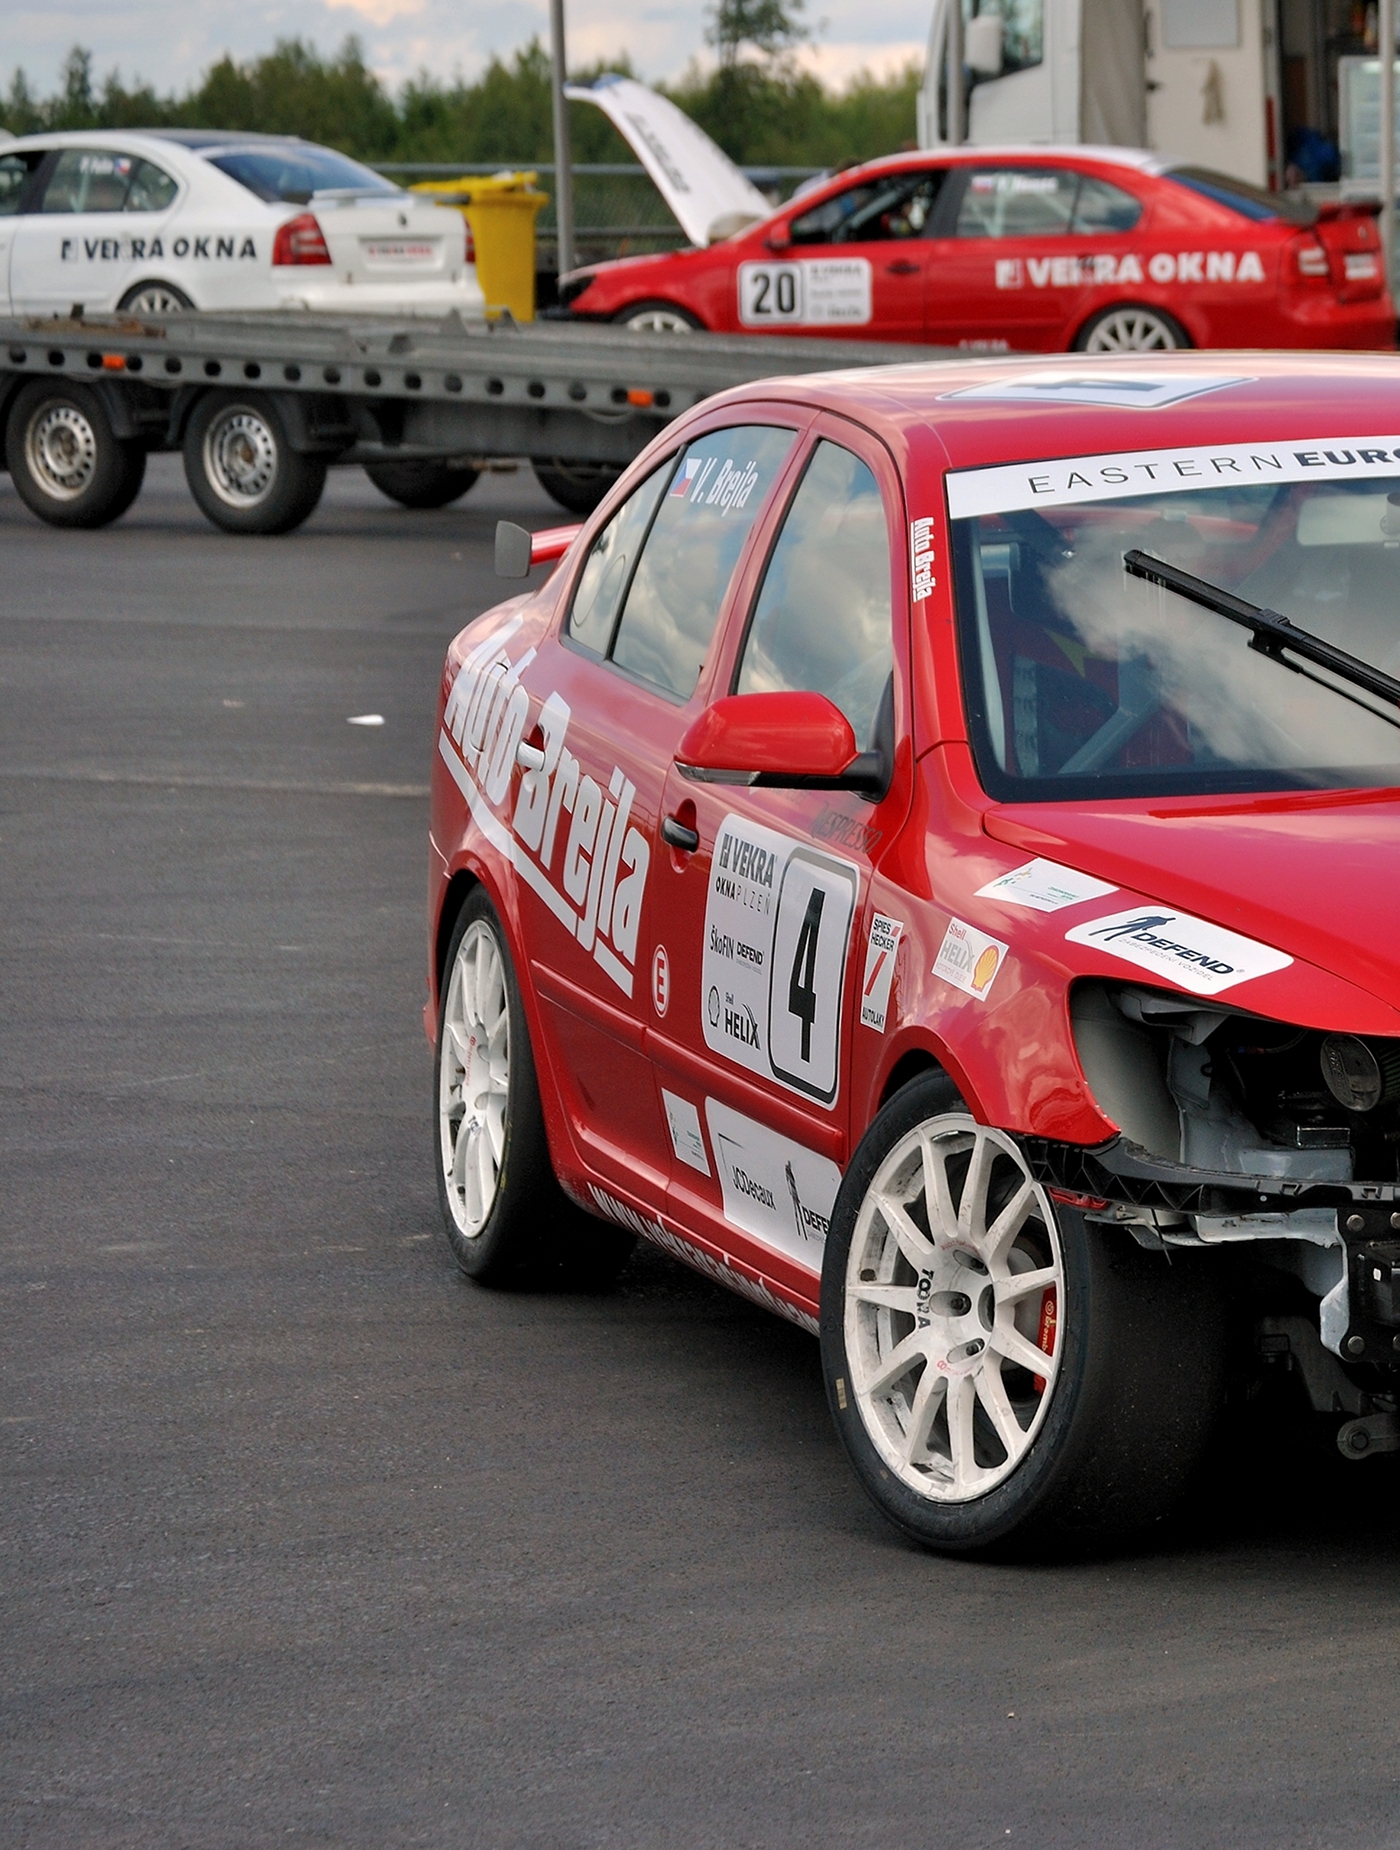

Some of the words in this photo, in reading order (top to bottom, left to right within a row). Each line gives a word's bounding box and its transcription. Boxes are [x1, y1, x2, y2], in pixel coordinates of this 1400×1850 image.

[172, 235, 258, 260] OKNA
[1148, 250, 1266, 285] OKNA
[752, 271, 797, 314] 20
[705, 458, 759, 518] Brejla
[1027, 454, 1284, 494] EASTERN
[914, 516, 935, 555] Auto
[912, 550, 937, 602] Brejla
[443, 613, 537, 807] Auto
[512, 690, 651, 967] Brejla
[731, 838, 776, 889] VEKRA
[715, 876, 736, 900] OKNA
[870, 932, 895, 952] HECKER
[873, 918, 892, 935] SPIES
[948, 923, 968, 941] Shell
[736, 941, 764, 966] DEFEND
[939, 939, 975, 974] HELIX
[1130, 932, 1235, 974] DEFEND
[788, 887, 827, 1064] 4
[724, 1006, 761, 1051] HELIX
[1041, 1315, 1052, 1352] bremb
